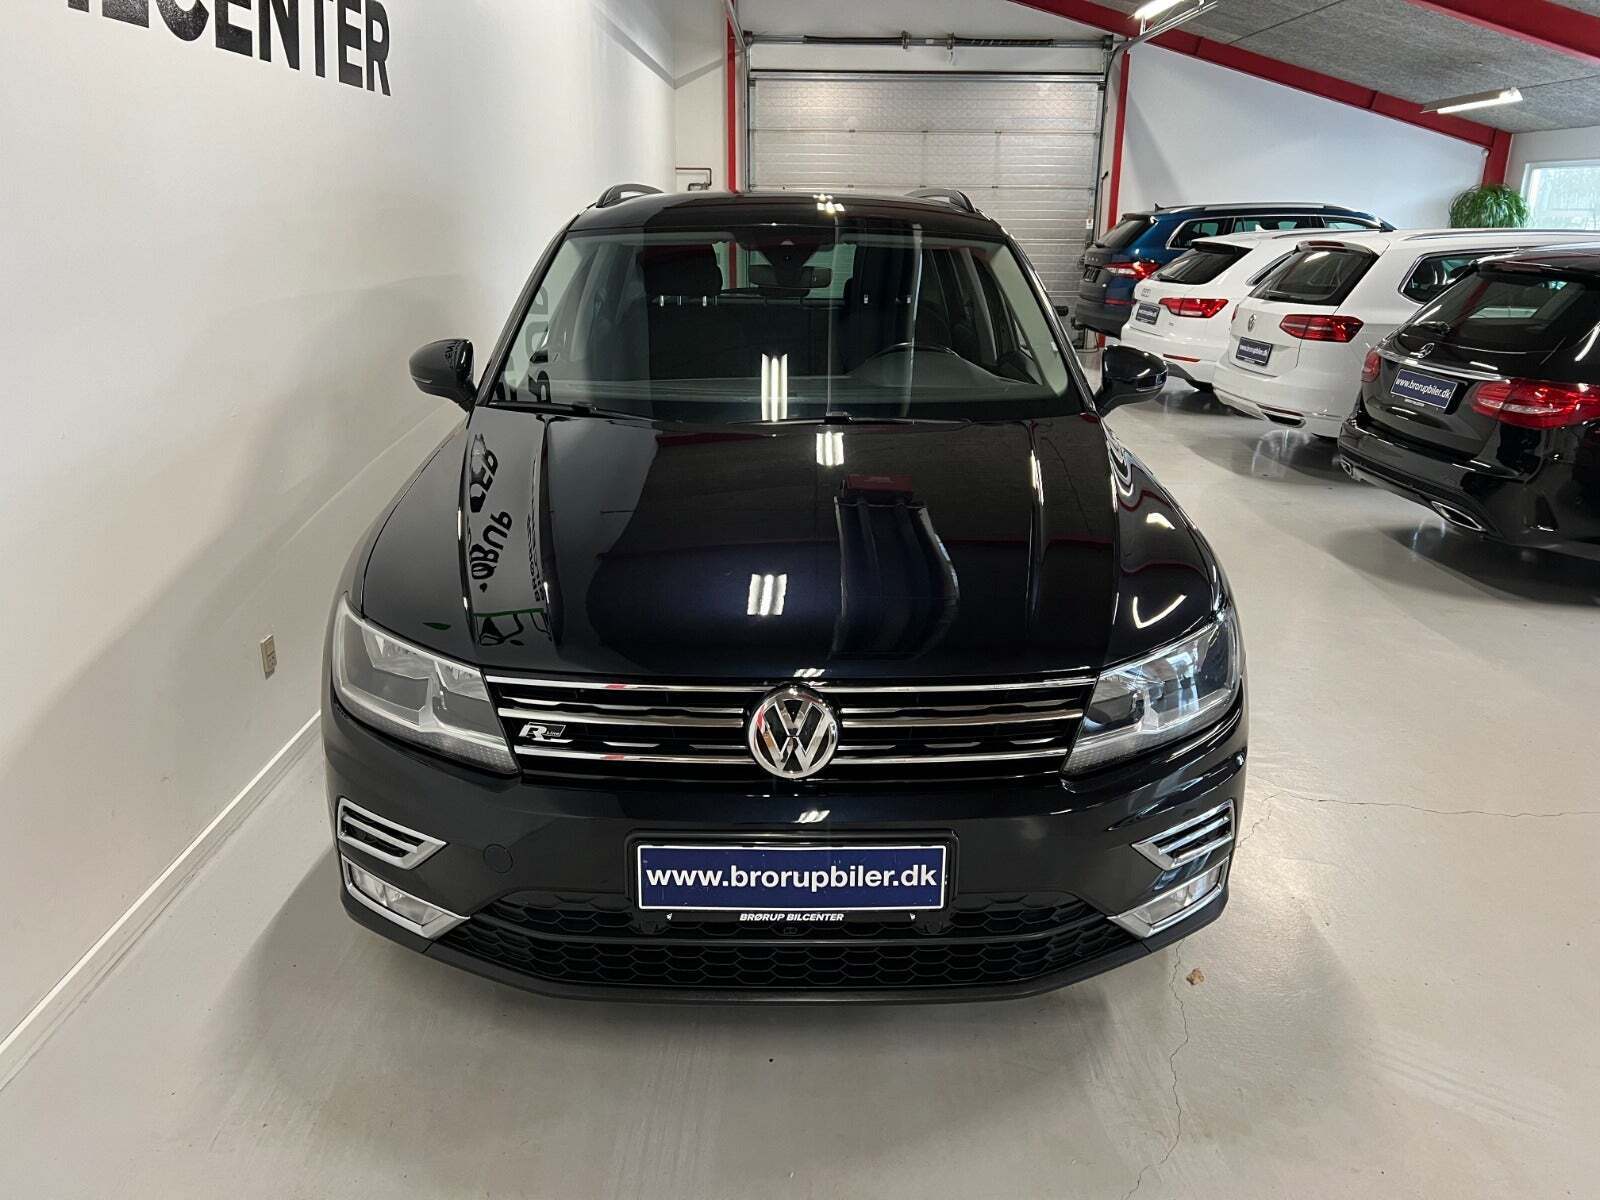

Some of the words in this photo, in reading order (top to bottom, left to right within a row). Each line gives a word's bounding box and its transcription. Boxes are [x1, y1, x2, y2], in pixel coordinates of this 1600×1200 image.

[1395, 378, 1452, 399] www.brorupbiler.dk
[646, 864, 937, 893] www.brorupbiler.dk
[739, 912, 785, 922] BRØRUP
[786, 912, 845, 922] BILCENTER
